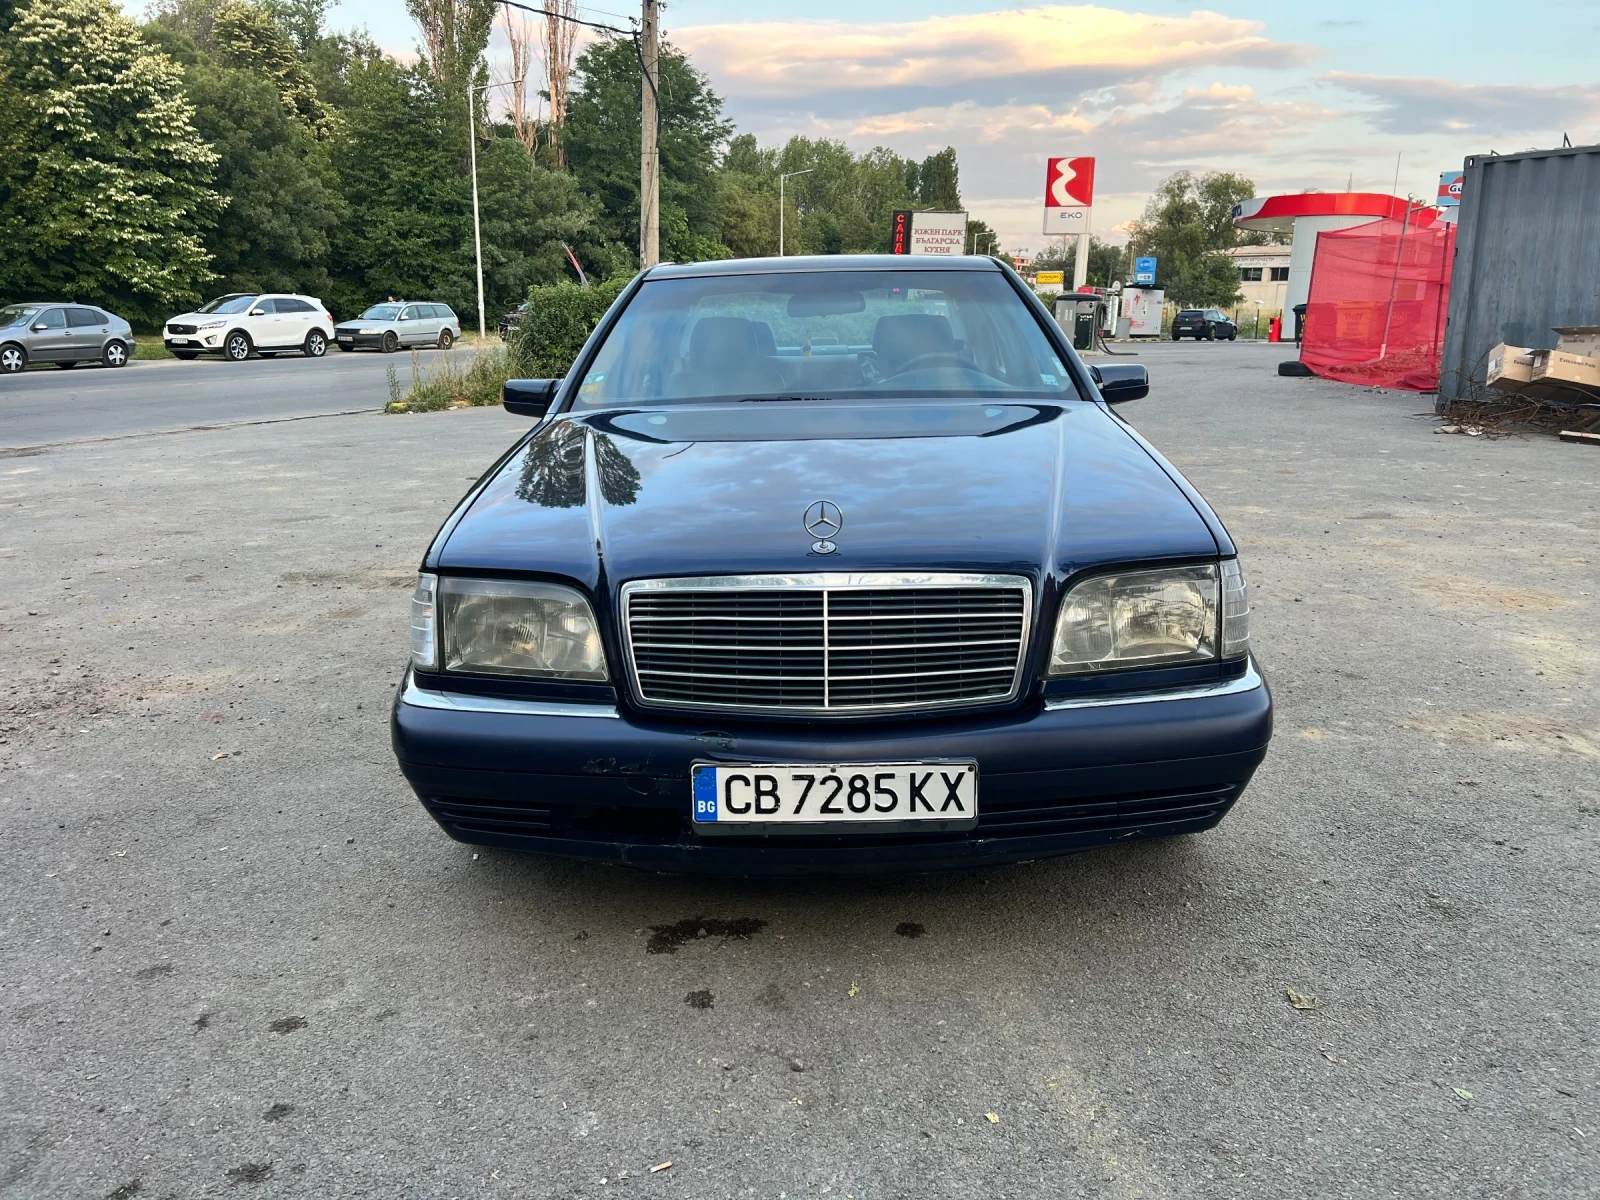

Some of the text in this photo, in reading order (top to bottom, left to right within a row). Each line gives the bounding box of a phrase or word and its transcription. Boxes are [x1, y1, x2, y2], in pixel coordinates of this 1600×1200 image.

[1060, 211, 1083, 219] EKO
[914, 228, 963, 236] ЮЖЕН ПАРК
[915, 237, 960, 245] БЪЛГАРСКА
[924, 246, 951, 254] КУХНЯ
[1559, 357, 1585, 366] Extension
[698, 771, 967, 815] BG CB 7285 KX
